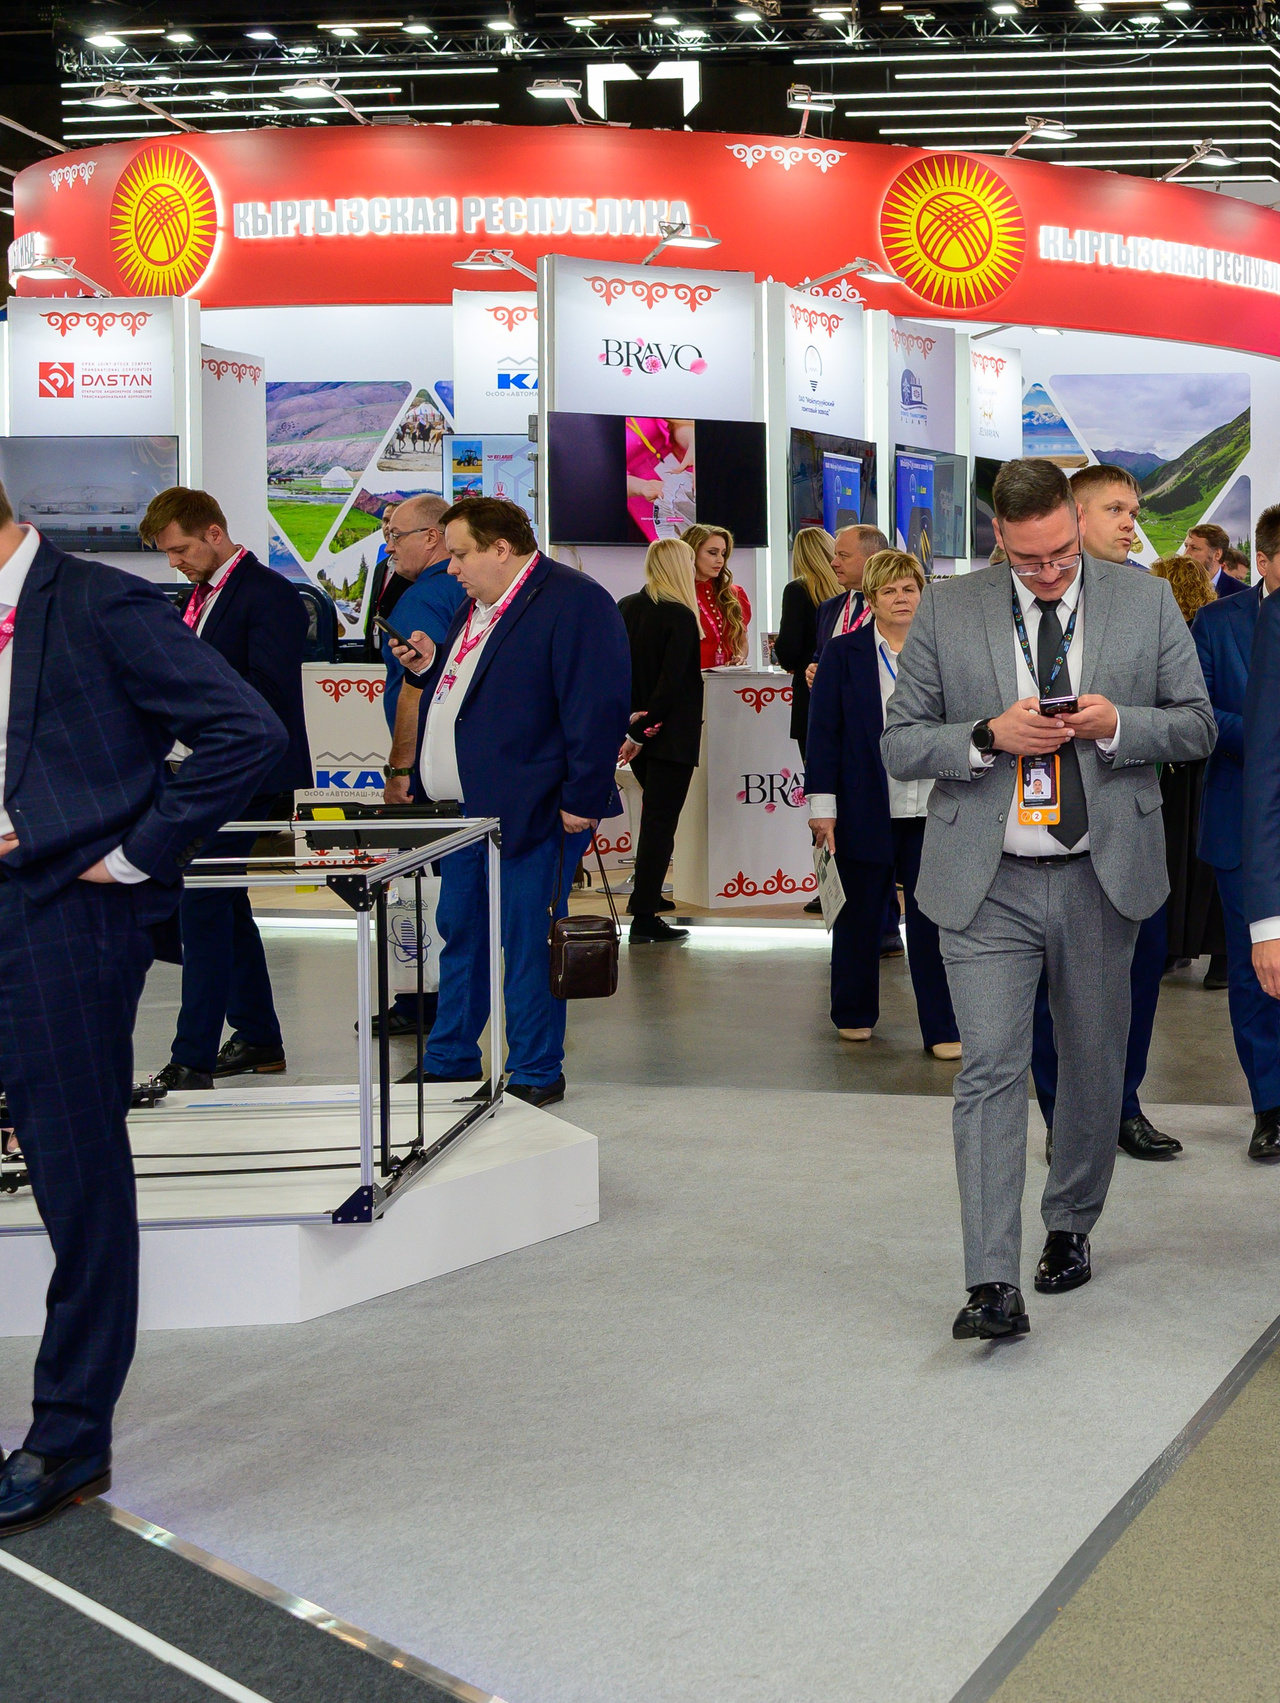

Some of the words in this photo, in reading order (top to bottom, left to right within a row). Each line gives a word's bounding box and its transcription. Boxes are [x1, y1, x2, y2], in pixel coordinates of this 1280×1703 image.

[233, 197, 455, 238] КЫРГЫЗСКАЯ
[462, 197, 691, 236] РЕСПУБЛИКА
[1041, 225, 1209, 278] КЫРГЫЗСКАЯ
[601, 338, 704, 375] BRAVO
[81, 374, 153, 387] DASTAN
[741, 772, 805, 808] BRA
